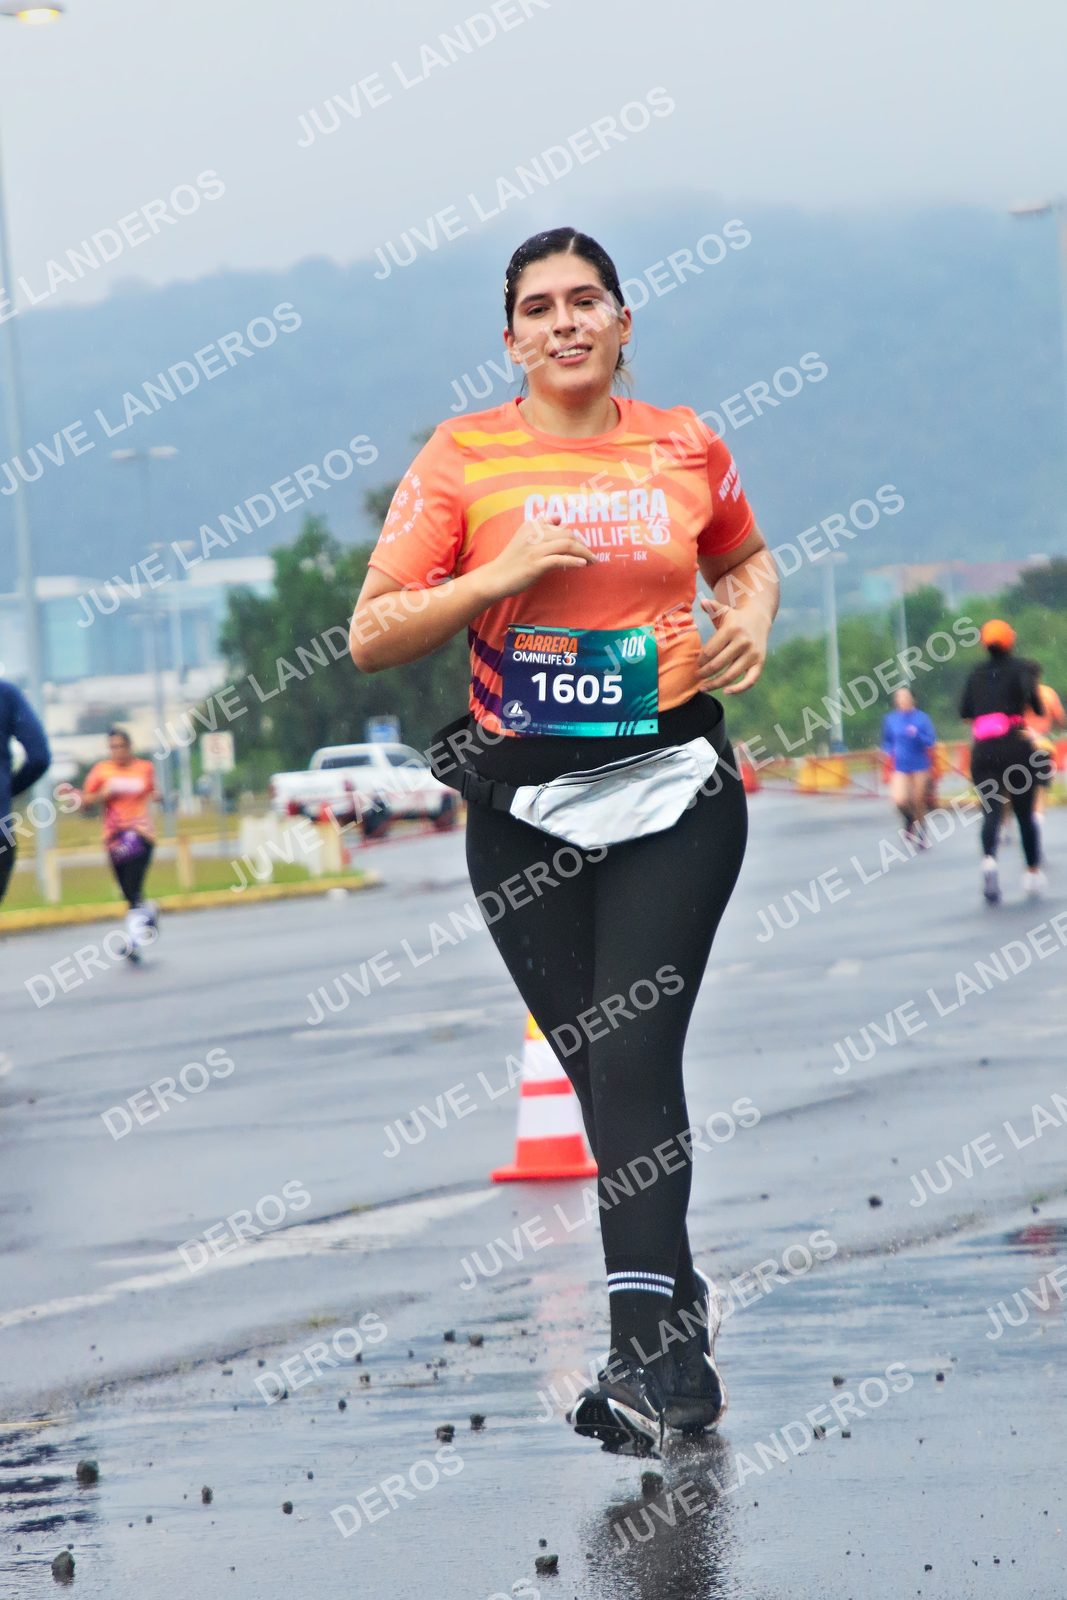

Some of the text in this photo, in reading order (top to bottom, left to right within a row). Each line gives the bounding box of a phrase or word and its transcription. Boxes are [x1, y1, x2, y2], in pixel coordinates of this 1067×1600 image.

[524, 488, 669, 523] CARRERA
[573, 525, 642, 548] NILIFE
[514, 633, 578, 652] CARRERA
[621, 635, 647, 658] 10K
[512, 651, 562, 665] OMNILIFE
[531, 672, 623, 705] 1605
